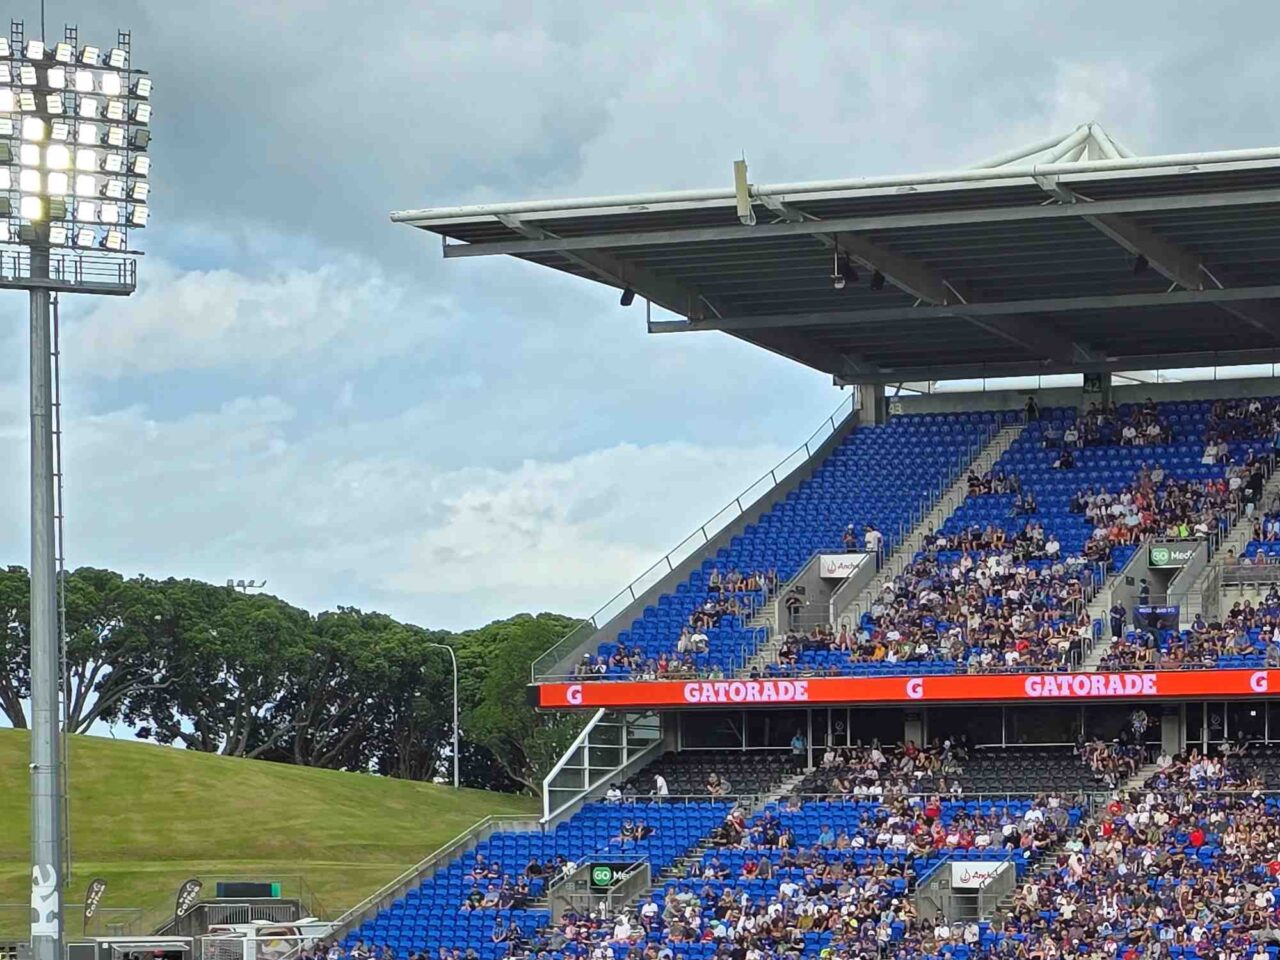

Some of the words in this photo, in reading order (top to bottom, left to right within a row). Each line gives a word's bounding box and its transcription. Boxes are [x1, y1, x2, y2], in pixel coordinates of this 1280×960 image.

[1152, 551, 1168, 560] GO
[594, 571, 610, 580] GO
[684, 680, 808, 703] GATORADE
[907, 678, 924, 699] G
[1024, 674, 1158, 698] GATORADE
[1250, 670, 1268, 693] G
[566, 684, 582, 705] G
[177, 885, 200, 917] Coffee
